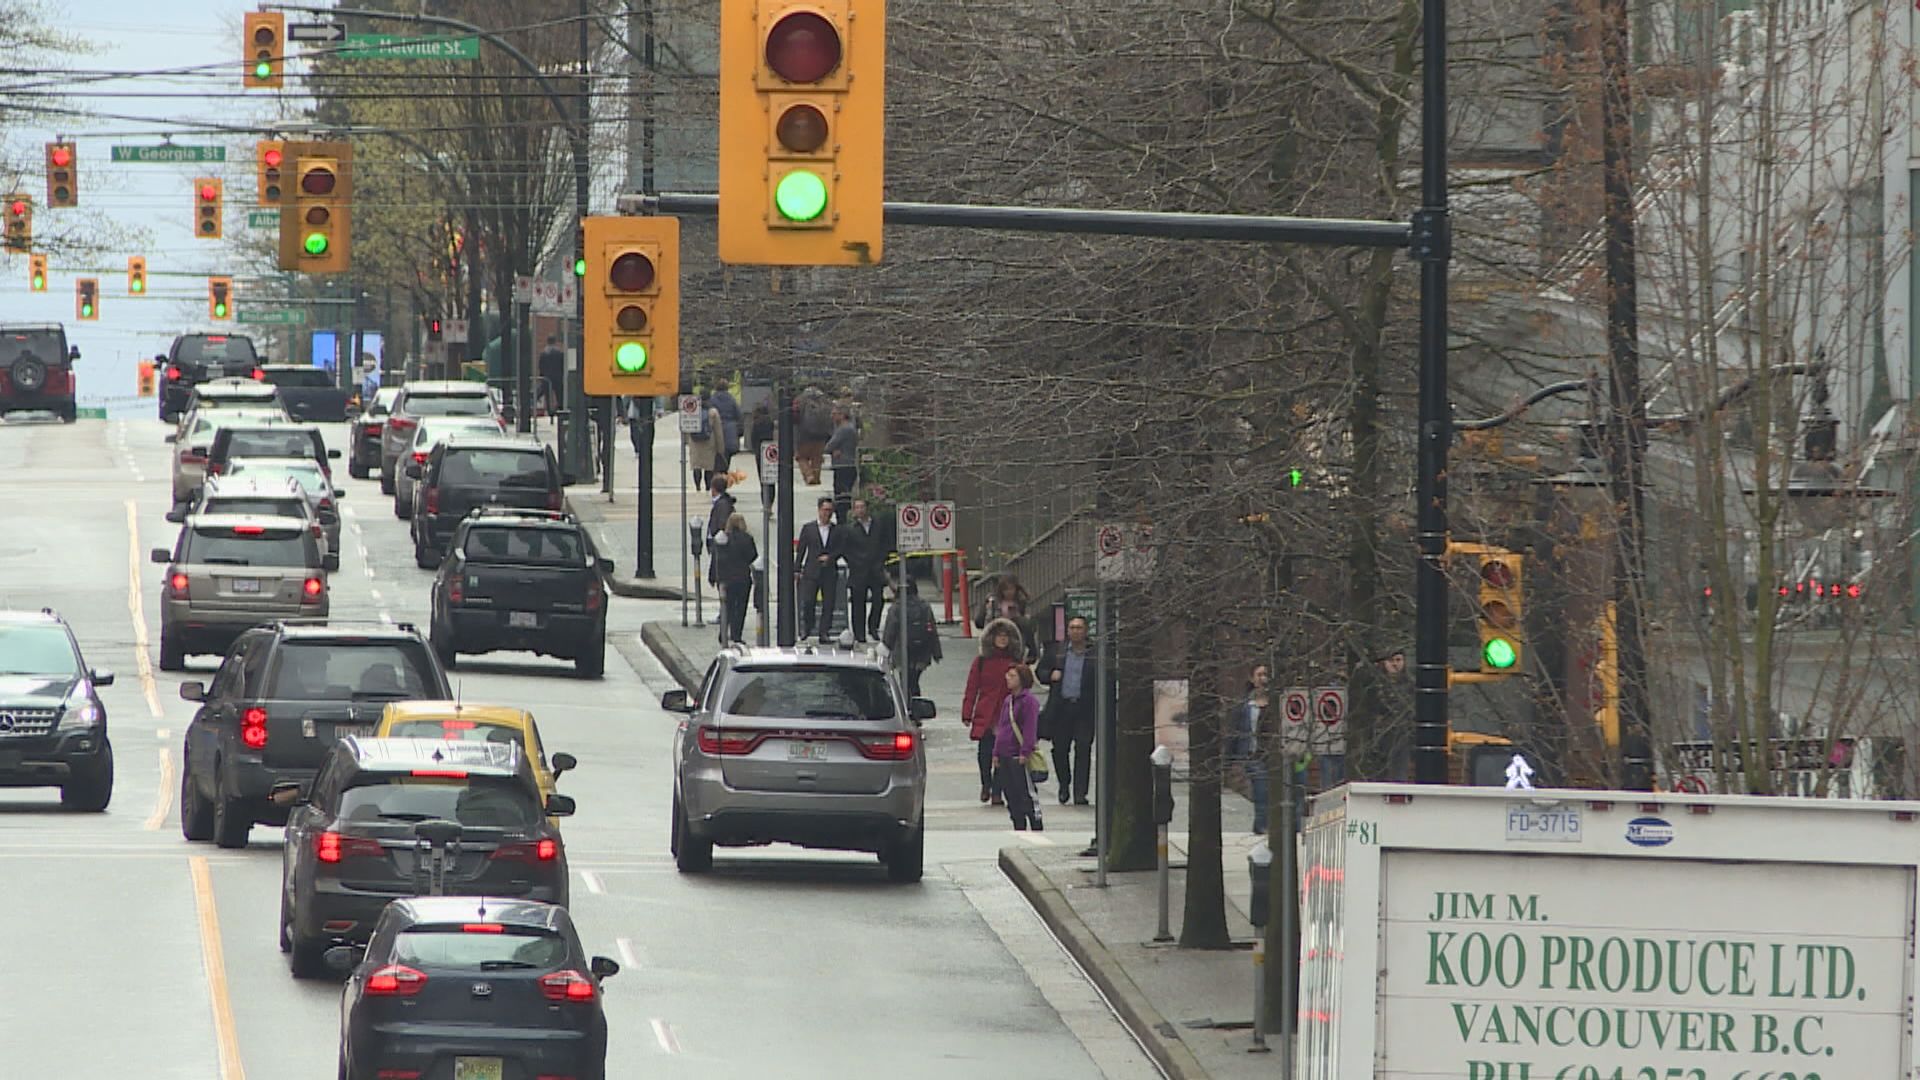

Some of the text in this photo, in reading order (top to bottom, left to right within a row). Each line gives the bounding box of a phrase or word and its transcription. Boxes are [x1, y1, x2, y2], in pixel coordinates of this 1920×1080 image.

[380, 39, 466, 54] Melville St.
[119, 147, 219, 161] W Georgia St
[1347, 819, 1379, 845] #81
[1428, 892, 1549, 922] JIM M.
[1425, 930, 1867, 1001] KOO PRODUCE LTD.
[1451, 1002, 1835, 1057] VANCOUVER B.C.
